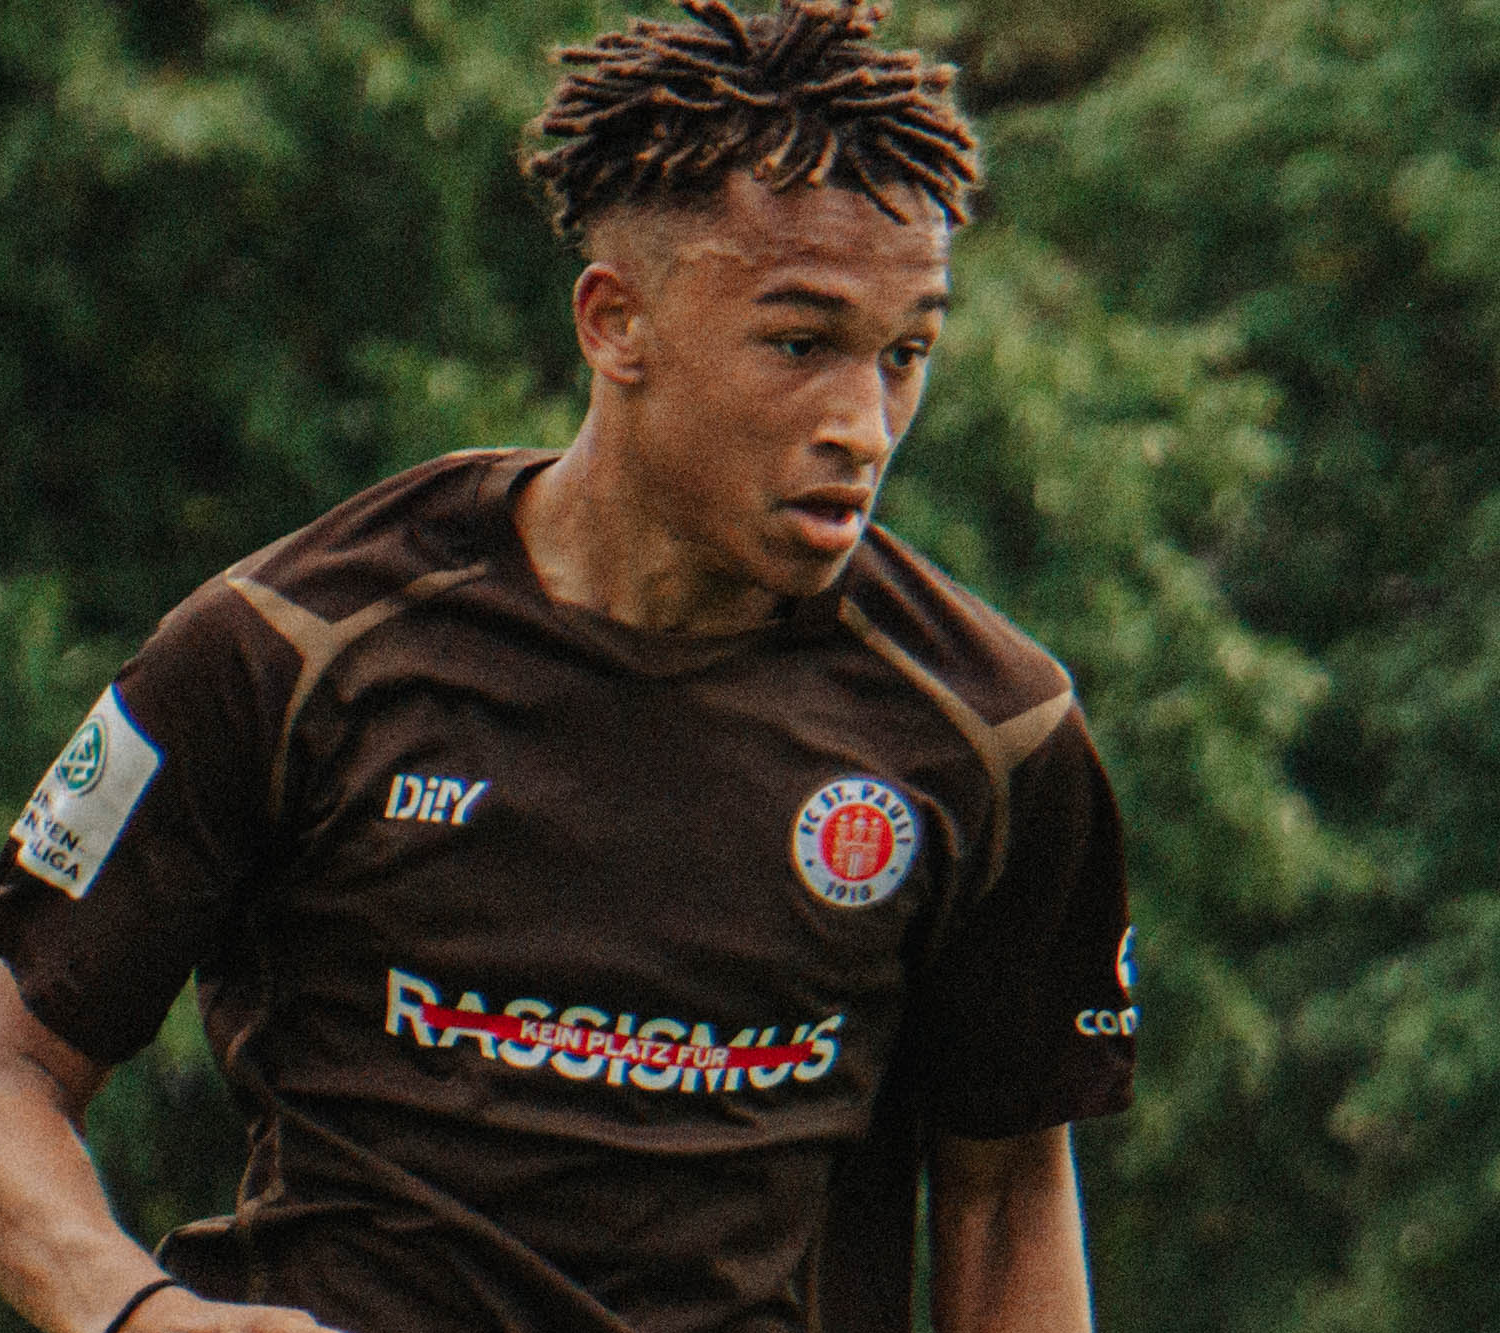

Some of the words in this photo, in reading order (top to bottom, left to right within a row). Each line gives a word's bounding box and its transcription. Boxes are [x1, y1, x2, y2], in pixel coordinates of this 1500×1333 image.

[799, 809, 821, 836] FC
[860, 782, 913, 846] PAULI
[824, 880, 874, 902] 1910
[384, 968, 845, 1094] RASSISMUS
[518, 1018, 582, 1052] KEIN
[586, 1030, 672, 1064] PLATZ
